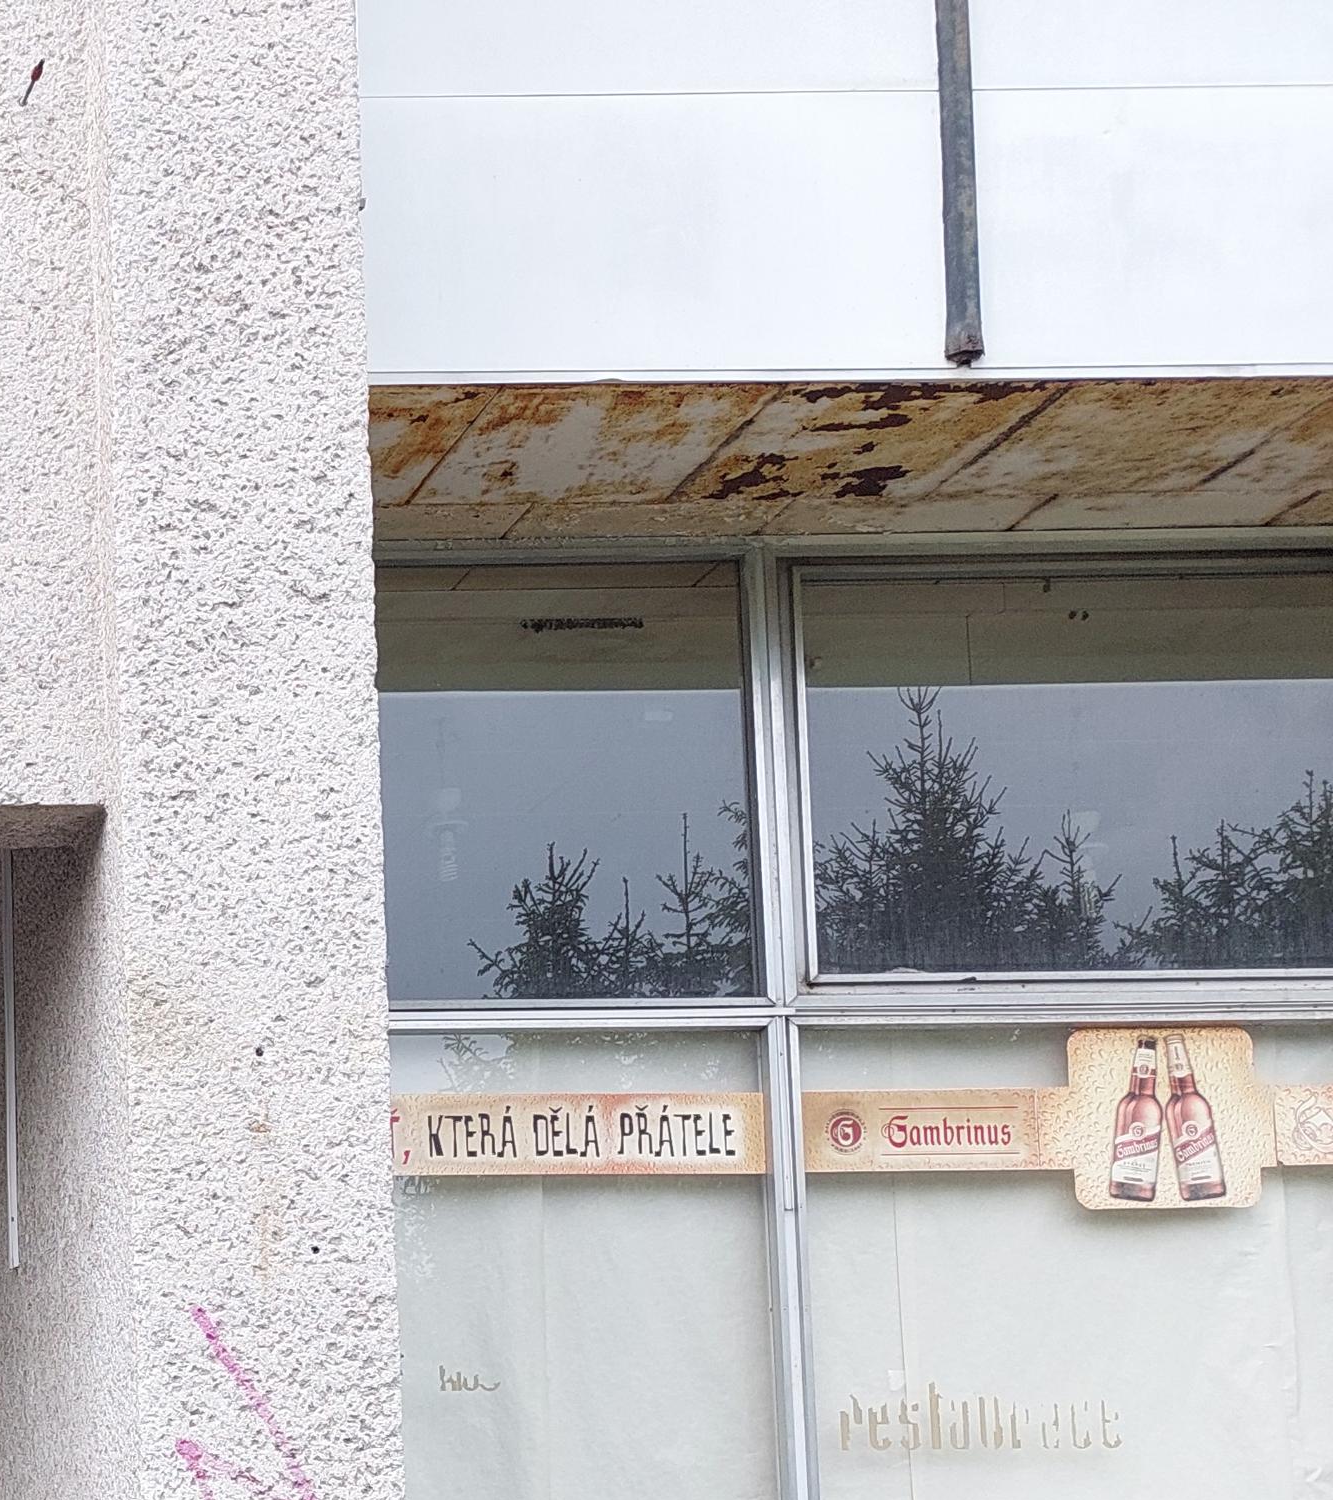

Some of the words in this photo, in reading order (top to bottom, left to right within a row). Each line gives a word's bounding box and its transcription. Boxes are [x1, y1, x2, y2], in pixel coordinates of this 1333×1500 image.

[428, 1105, 518, 1158] KTERÁ
[533, 1105, 600, 1158] DĚLÁ
[617, 1105, 737, 1158] PŘÁTELE
[880, 1115, 1013, 1149] Gambrinus
